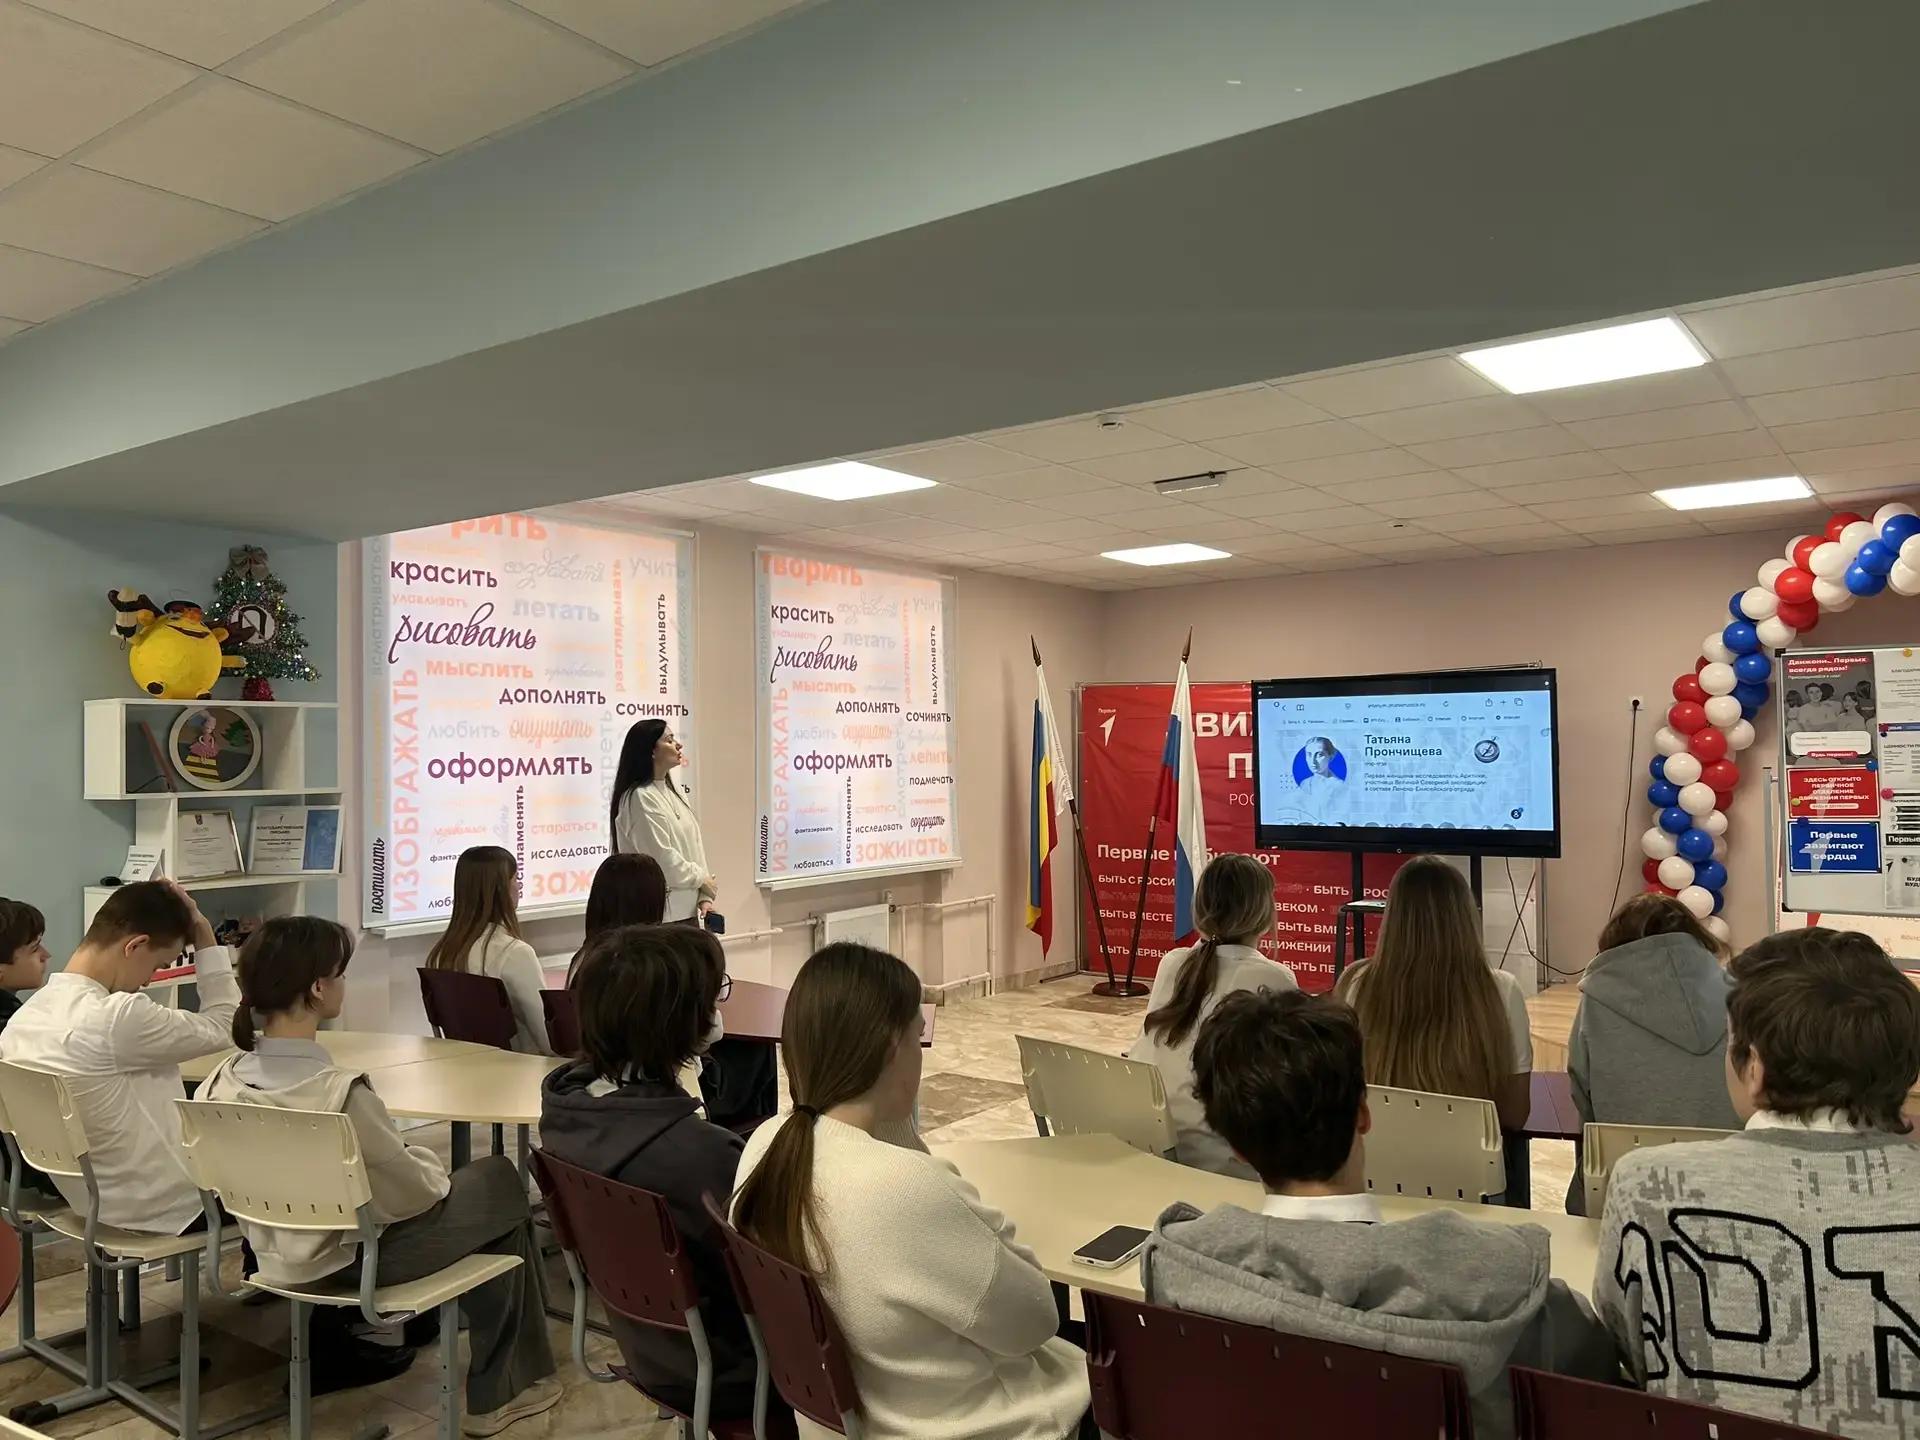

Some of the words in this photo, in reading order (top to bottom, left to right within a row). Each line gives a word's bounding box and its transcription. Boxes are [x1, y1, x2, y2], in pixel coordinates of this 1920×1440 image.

[390, 560, 499, 589] красить
[503, 548, 606, 590] создавать
[629, 556, 687, 578] учить
[761, 554, 864, 587] творить
[392, 592, 469, 609] улавливать
[512, 597, 600, 623] летать
[771, 604, 835, 626] красить
[388, 602, 537, 665] рисовать
[613, 558, 625, 693] разглядывать
[657, 593, 669, 695] выдумывать
[842, 631, 896, 650] летать
[769, 634, 859, 684] рисовать
[930, 624, 939, 705] выдумывать
[1834, 656, 1867, 665] Первых
[426, 660, 534, 680] мыслить
[1788, 666, 1817, 674] всегда
[1818, 665, 1848, 673] рядом!
[499, 687, 607, 706] дополнять
[792, 680, 858, 695] мыслить
[615, 702, 690, 718] сочинять
[835, 700, 901, 715] дополнять
[905, 711, 952, 723] сочинять
[427, 720, 501, 740] любить
[792, 725, 838, 742] любить
[1364, 734, 1412, 745] Татьяна
[909, 749, 953, 765] лепить
[1364, 746, 1443, 759] Прончищева
[427, 751, 593, 785] оформлять
[793, 750, 893, 776] оформлять
[772, 687, 790, 873] ИЗОБРАЖАТЬ
[909, 775, 955, 787] подмечать
[392, 668, 420, 914] ИЗОБРАЖАТЬ
[531, 822, 599, 836] стараться
[845, 775, 853, 865] воспламенять
[855, 823, 904, 835] исследовать
[515, 784, 526, 900] воспламенять
[1809, 831, 1858, 840] Первые
[531, 845, 609, 861] исследовать
[856, 836, 950, 864] зажигать
[1812, 853, 1857, 861] сердца
[793, 859, 835, 871] любоваться
[371, 837, 386, 916] постигать
[1098, 874, 1127, 885] БЫТЬ
[1128, 875, 1136, 885] С
[1314, 885, 1349, 896] БЫТЬ
[1277, 921, 1312, 933] БЫТЬ
